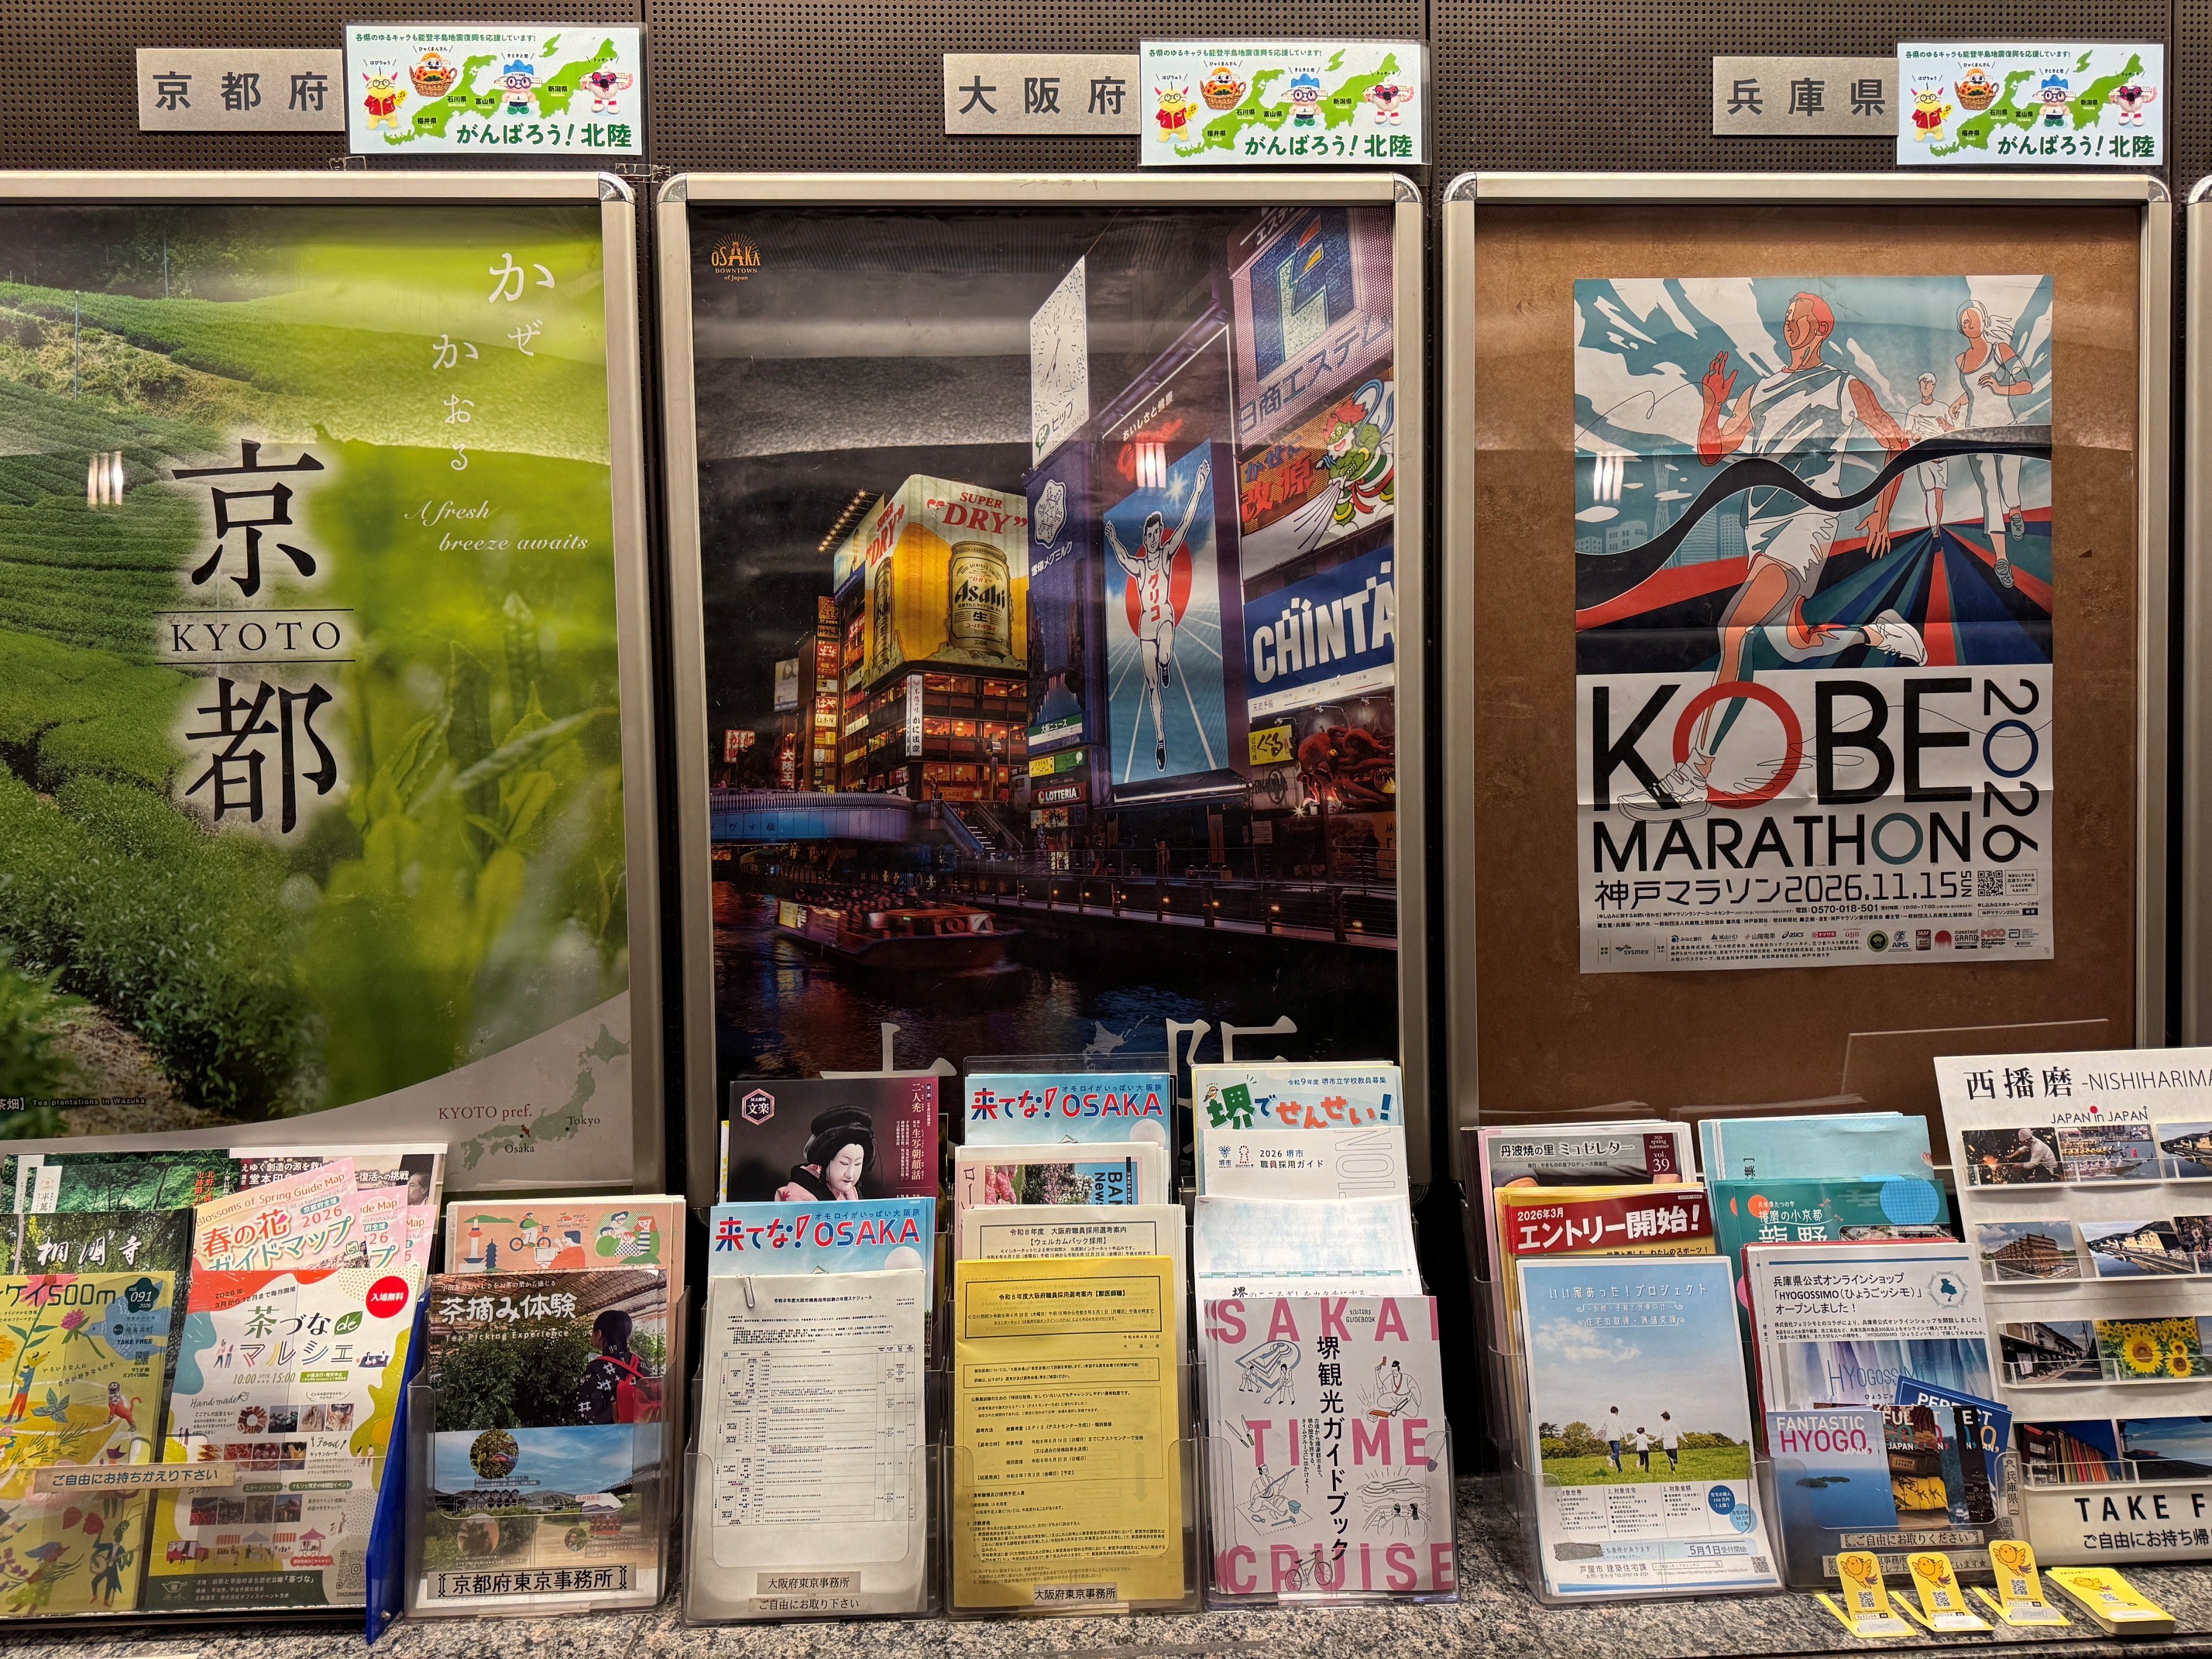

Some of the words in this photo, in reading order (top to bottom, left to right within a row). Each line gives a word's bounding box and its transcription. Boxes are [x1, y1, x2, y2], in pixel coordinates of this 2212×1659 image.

[152, 71, 328, 112] 京都府
[959, 75, 1127, 115] 大阪府
[1727, 77, 1886, 117] 兵庫県
[711, 242, 761, 266] OSAKA
[488, 252, 555, 357] かぜ
[432, 334, 479, 471] かおる
[960, 492, 1003, 509] SUPER
[422, 500, 490, 527] fresh
[439, 532, 510, 552] breeze
[517, 534, 589, 551] awaits
[955, 579, 1005, 610] Asahi
[1148, 568, 1162, 623] グリコ
[973, 611, 988, 622] 生
[171, 621, 342, 653] KYOTO
[1592, 678, 1973, 812] KOBE
[1983, 678, 2039, 864] 2026
[1045, 788, 1077, 802] LOTTERIA
[1594, 811, 1971, 874] MARATHON
[1961, 871, 1973, 898] SUN
[1062, 1084, 1163, 1093] オモロイがいっぱい大阪旅
[1321, 1075, 1387, 1085] 堺市立学校教員募集
[1963, 1066, 2073, 1101] 西播磨
[51, 1098, 98, 1107] plantations
[912, 1083, 922, 1113] 二人禿
[438, 1106, 497, 1120] KYOTO
[502, 1103, 533, 1121] pref.
[747, 1101, 770, 1115] 文楽
[2051, 1111, 2092, 1125] JAPAN
[2094, 1107, 2105, 1122] in
[2107, 1110, 2149, 1122] JAPAN
[567, 1115, 601, 1128] Tokyo
[505, 1144, 535, 1153] Osaka
[912, 1128, 922, 1180] 生写朝顔話
[1259, 1149, 1283, 1158] 2026
[1286, 1149, 1304, 1158] 堺市
[1500, 1143, 1555, 1158] 丹波焼の里
[1559, 1141, 1635, 1156] ミュゼレター
[1260, 1159, 1324, 1170] 職員採用ガイド
[1652, 1158, 1671, 1173] 39
[196, 1200, 242, 1227] Blossoms
[244, 1196, 256, 1207] of
[259, 1188, 292, 1206] Spring
[294, 1180, 322, 1197] Guide
[324, 1172, 345, 1188] Map
[303, 1198, 338, 1214] 京都府全域
[301, 1205, 343, 1228] 2026
[815, 1208, 921, 1220] オモロイがいっぱい大阪旅
[1516, 1207, 1565, 1222] 2026年3月
[1759, 1208, 1823, 1223] 播磨の小京都
[202, 1208, 290, 1257] 春の花
[1517, 1204, 1701, 1251] エントリー開始!
[208, 1214, 356, 1270] ガイドマップ
[1773, 1273, 1905, 1288] 兵庫県公式オンラインショップ
[0, 1283, 117, 1307] ケイ500m
[130, 1291, 152, 1303] 091
[215, 1289, 244, 1300] 2026年
[371, 1291, 404, 1302] 入場無料
[1550, 1283, 1707, 1300] いい家あった!プロジェクト
[438, 1292, 579, 1325] 茶摘み体験
[1775, 1302, 1857, 1315] オープンしました!
[245, 1305, 331, 1339] 茶づな
[336, 1314, 360, 1331] de
[1217, 1296, 1440, 1345] SAKAI
[445, 1334, 464, 1342] Tea
[468, 1331, 508, 1342] Picking
[511, 1329, 570, 1341] Experience
[239, 1339, 354, 1368] マルシェ
[233, 1373, 256, 1385] 10:00
[272, 1372, 296, 1383] 15:00
[1775, 1415, 1866, 1432] FANTASTIC
[317, 1437, 341, 1450] Food
[1249, 1419, 1431, 1468] TIME
[1316, 1335, 1348, 1561] 堺観光ガイドブック
[1841, 1447, 1869, 1456] JAPAN
[1887, 1442, 1915, 1451] JAPAN
[52, 1468, 218, 1486] ご自由にお持ちかえり下さい
[2005, 1471, 2019, 1505] 兵庫県
[2074, 1493, 2171, 1523] TAKE
[1856, 1532, 1970, 1546] ご自由にお取りください
[1689, 1544, 1747, 1556] 5月1日受付開始
[1227, 1541, 1455, 1594] CRUISE
[1579, 1565, 1604, 1574] 芦屋市
[1606, 1563, 1648, 1572] 建築住宅課
[452, 1568, 614, 1595] 京都府東京事務所
[768, 1576, 850, 1589] 大阪府東京事務所
[1034, 1587, 1117, 1600] 大阪府東京事務所
[759, 1597, 860, 1612] ご自由にお取り下さい
